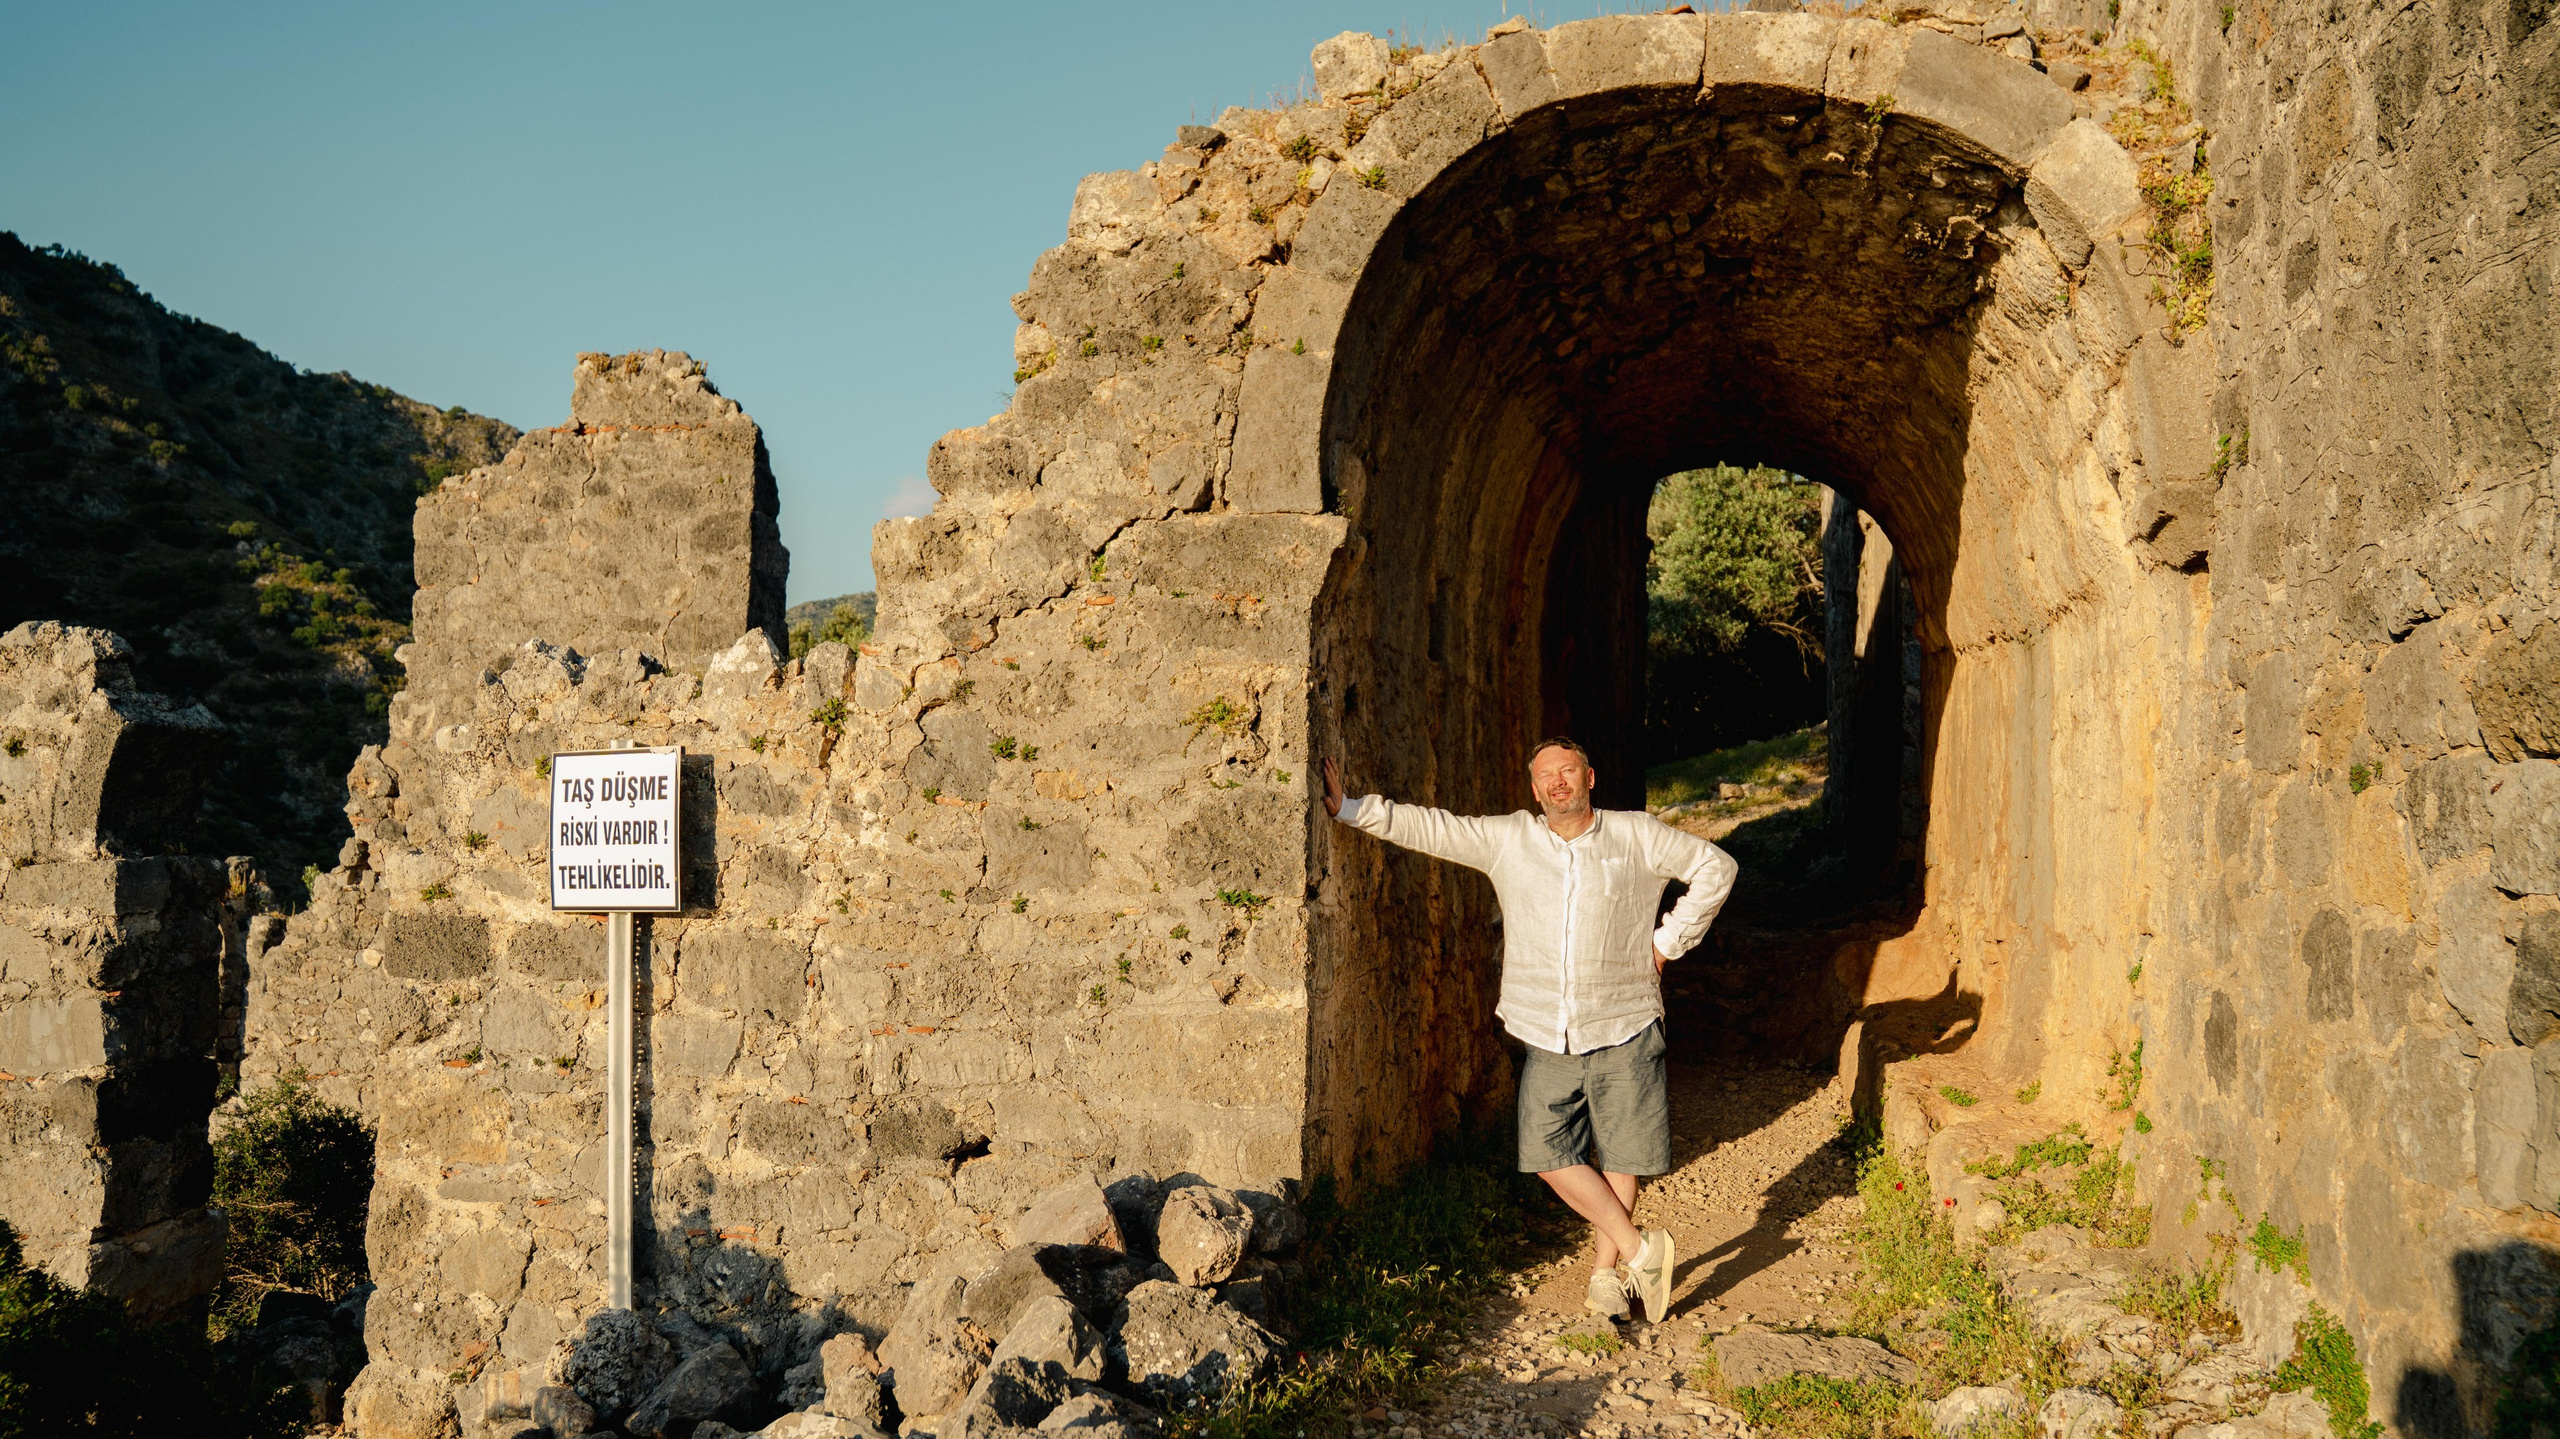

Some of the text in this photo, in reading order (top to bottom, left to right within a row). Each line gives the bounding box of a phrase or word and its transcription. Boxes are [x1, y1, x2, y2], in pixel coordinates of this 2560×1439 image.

[562, 771, 668, 809] TAŞ DÜŞME
[560, 815, 668, 846] RİSKİ VARDIR !
[558, 858, 670, 889] TEHLİKELİDİR.
